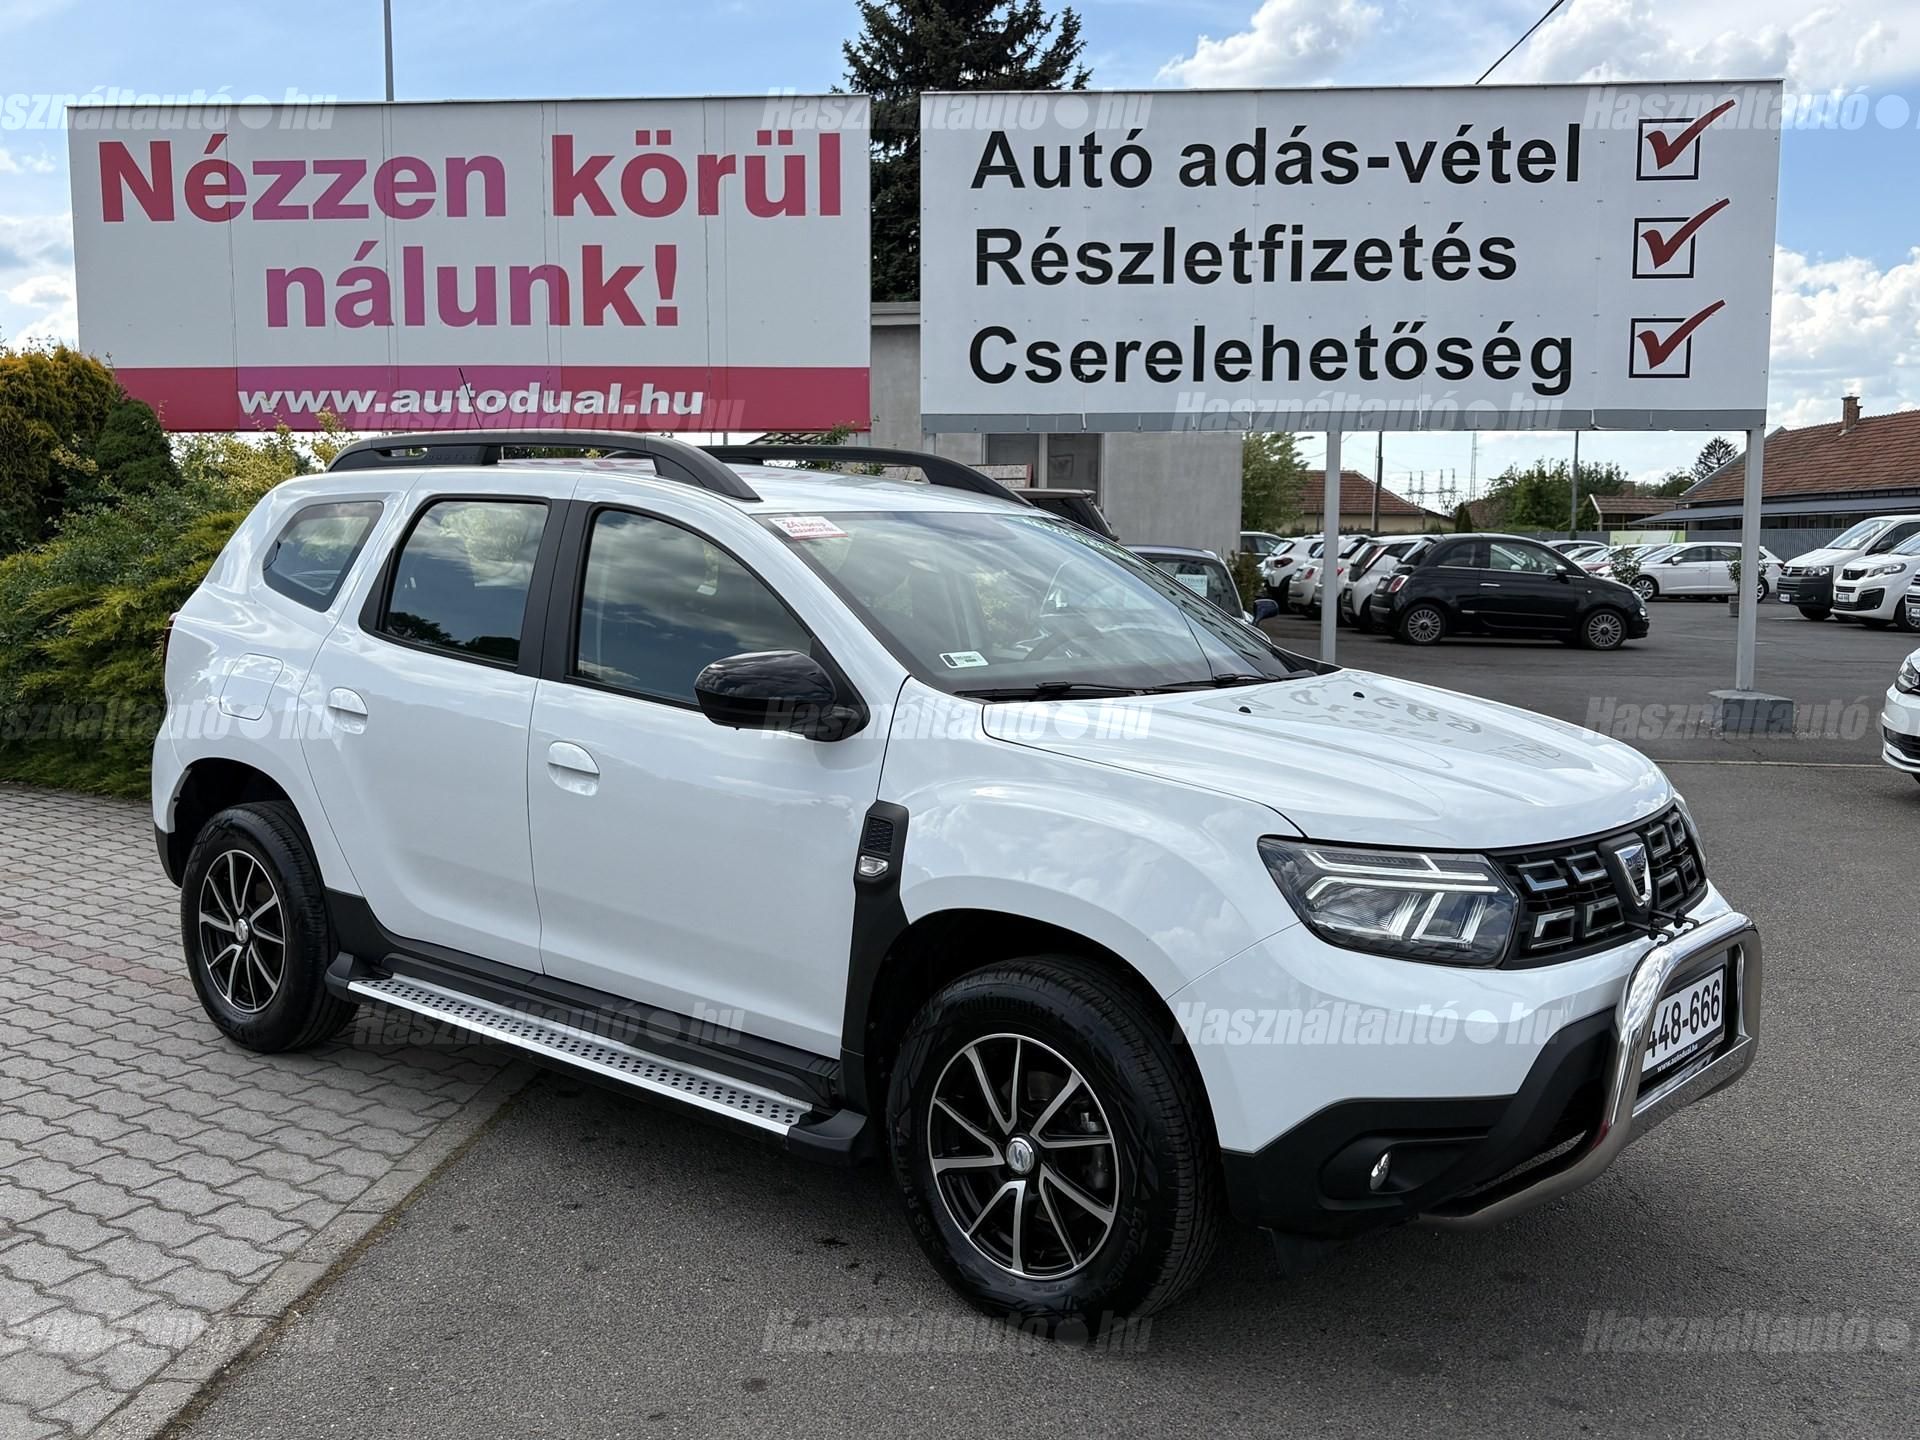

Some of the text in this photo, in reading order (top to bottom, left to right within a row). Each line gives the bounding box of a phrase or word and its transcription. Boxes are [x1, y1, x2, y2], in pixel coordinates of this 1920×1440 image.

[100, 130, 840, 222] Nézzen körül
[971, 123, 1580, 189] Autó adás-vétel
[267, 241, 678, 328] nálunk!
[976, 221, 1517, 286] Részletfizetés
[969, 321, 1572, 396] Cserelehetőség
[238, 382, 704, 416] www.autodual.hu
